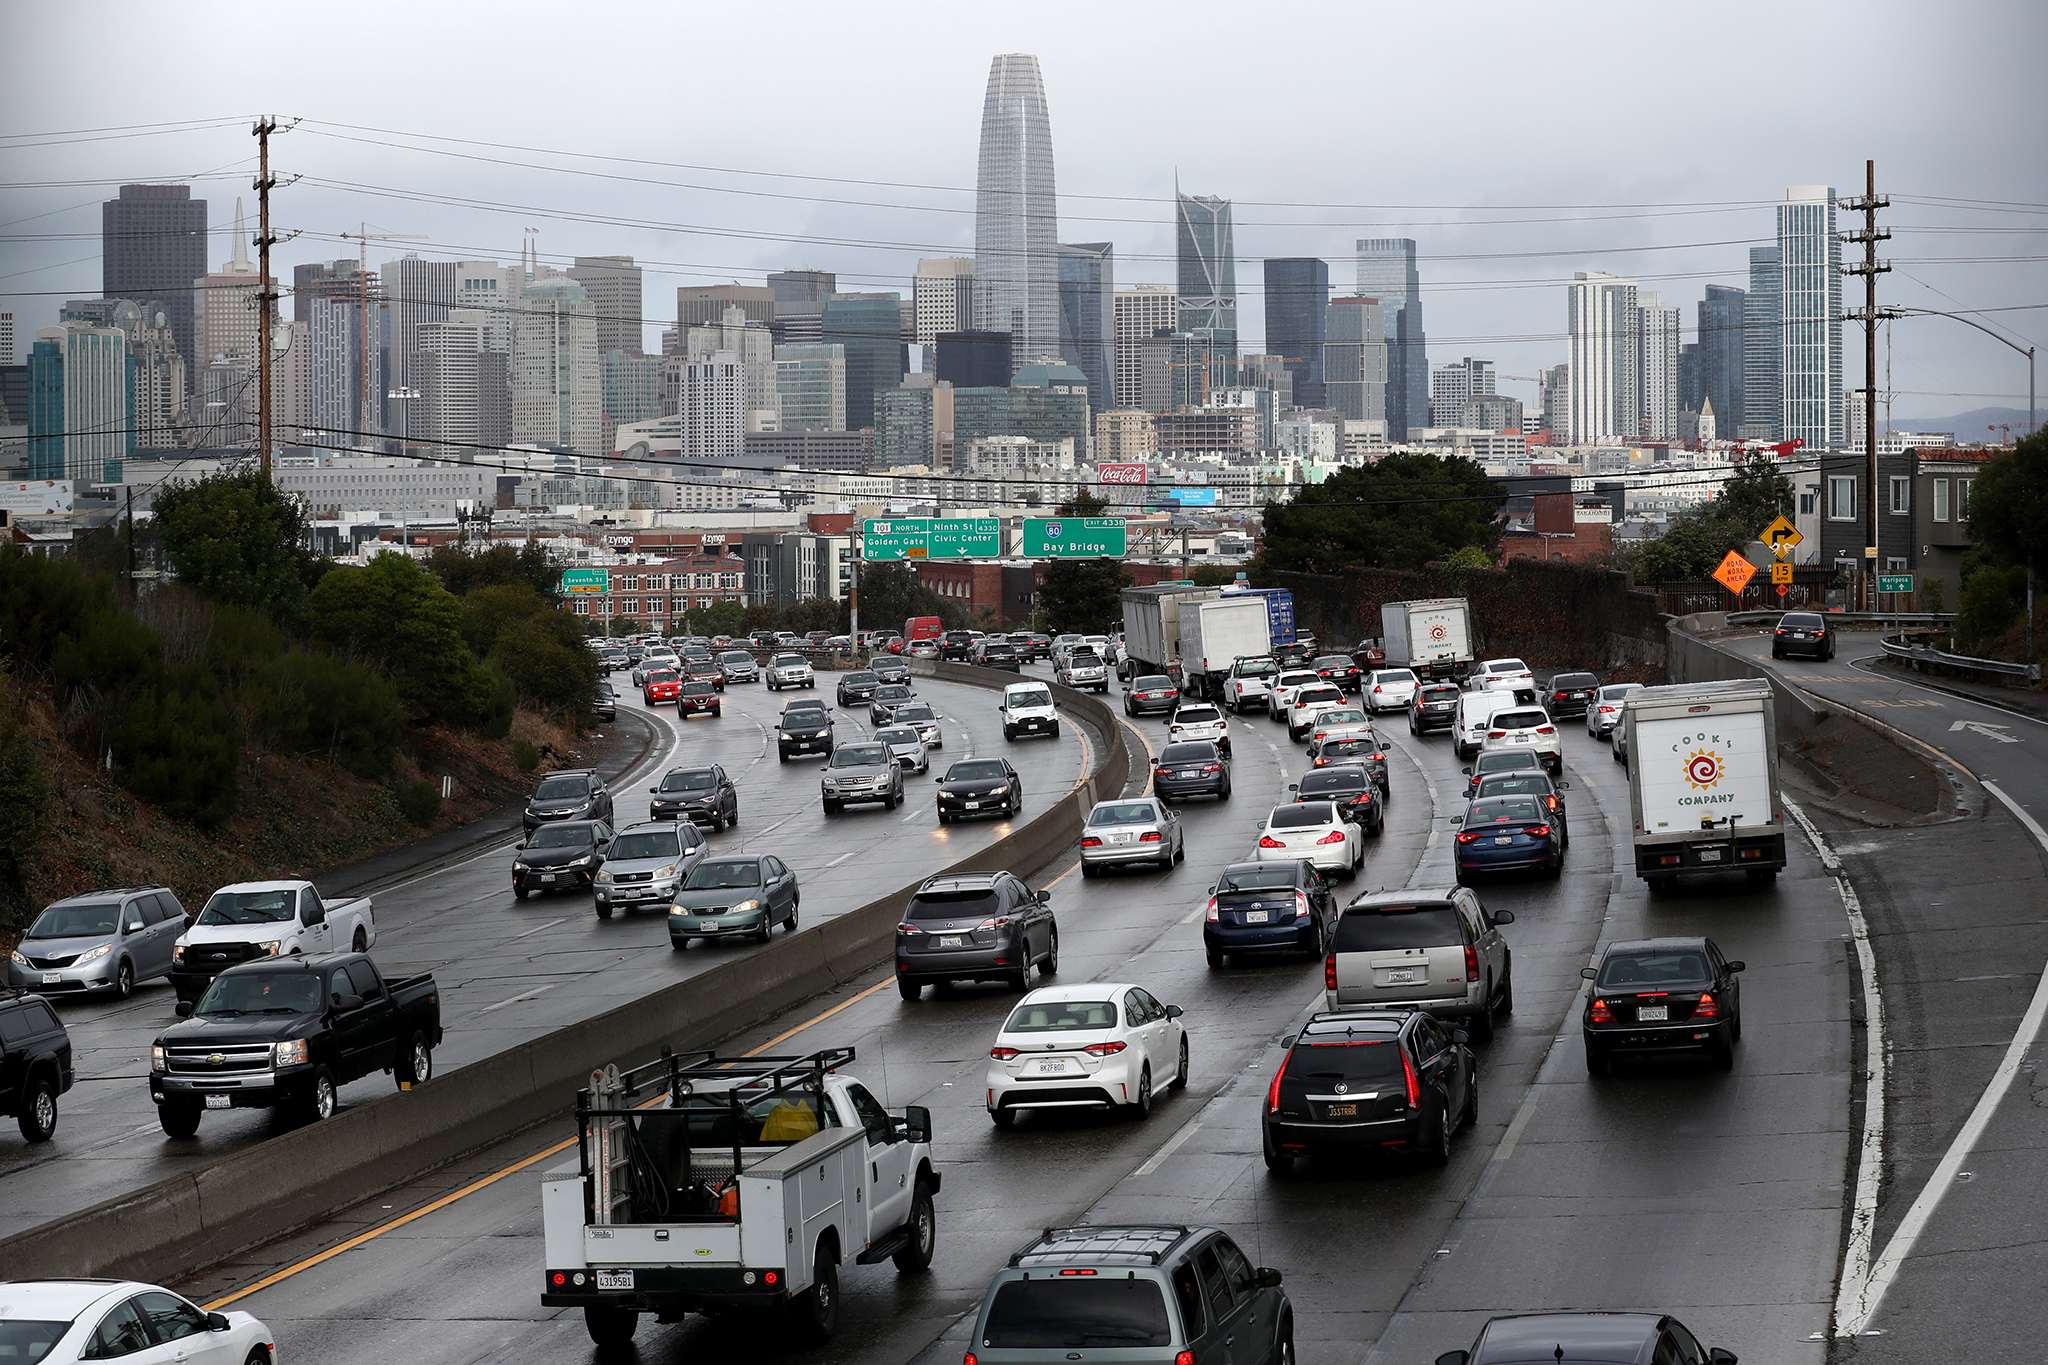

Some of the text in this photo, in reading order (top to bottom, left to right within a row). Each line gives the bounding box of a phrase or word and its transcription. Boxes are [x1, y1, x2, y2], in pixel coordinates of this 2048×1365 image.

[1100, 466, 1144, 483] Coca-Cola
[876, 524, 888, 532] 101
[934, 523, 973, 531] Ninth St
[1048, 527, 1060, 536] 80
[608, 536, 634, 546] zynga
[706, 534, 726, 544] zynga
[868, 538, 899, 546] Golden
[961, 534, 992, 542] Center
[1043, 542, 1106, 553] Bay Bridge
[1726, 560, 1743, 568] ROAD
[1776, 566, 1789, 576] 15
[1726, 574, 1747, 582] AHEAD
[1672, 732, 1732, 753] COOKS
[1677, 793, 1735, 806] COMPANY
[1329, 1107, 1357, 1117] JSSTRRR
[599, 1276, 632, 1287] 43195B1
